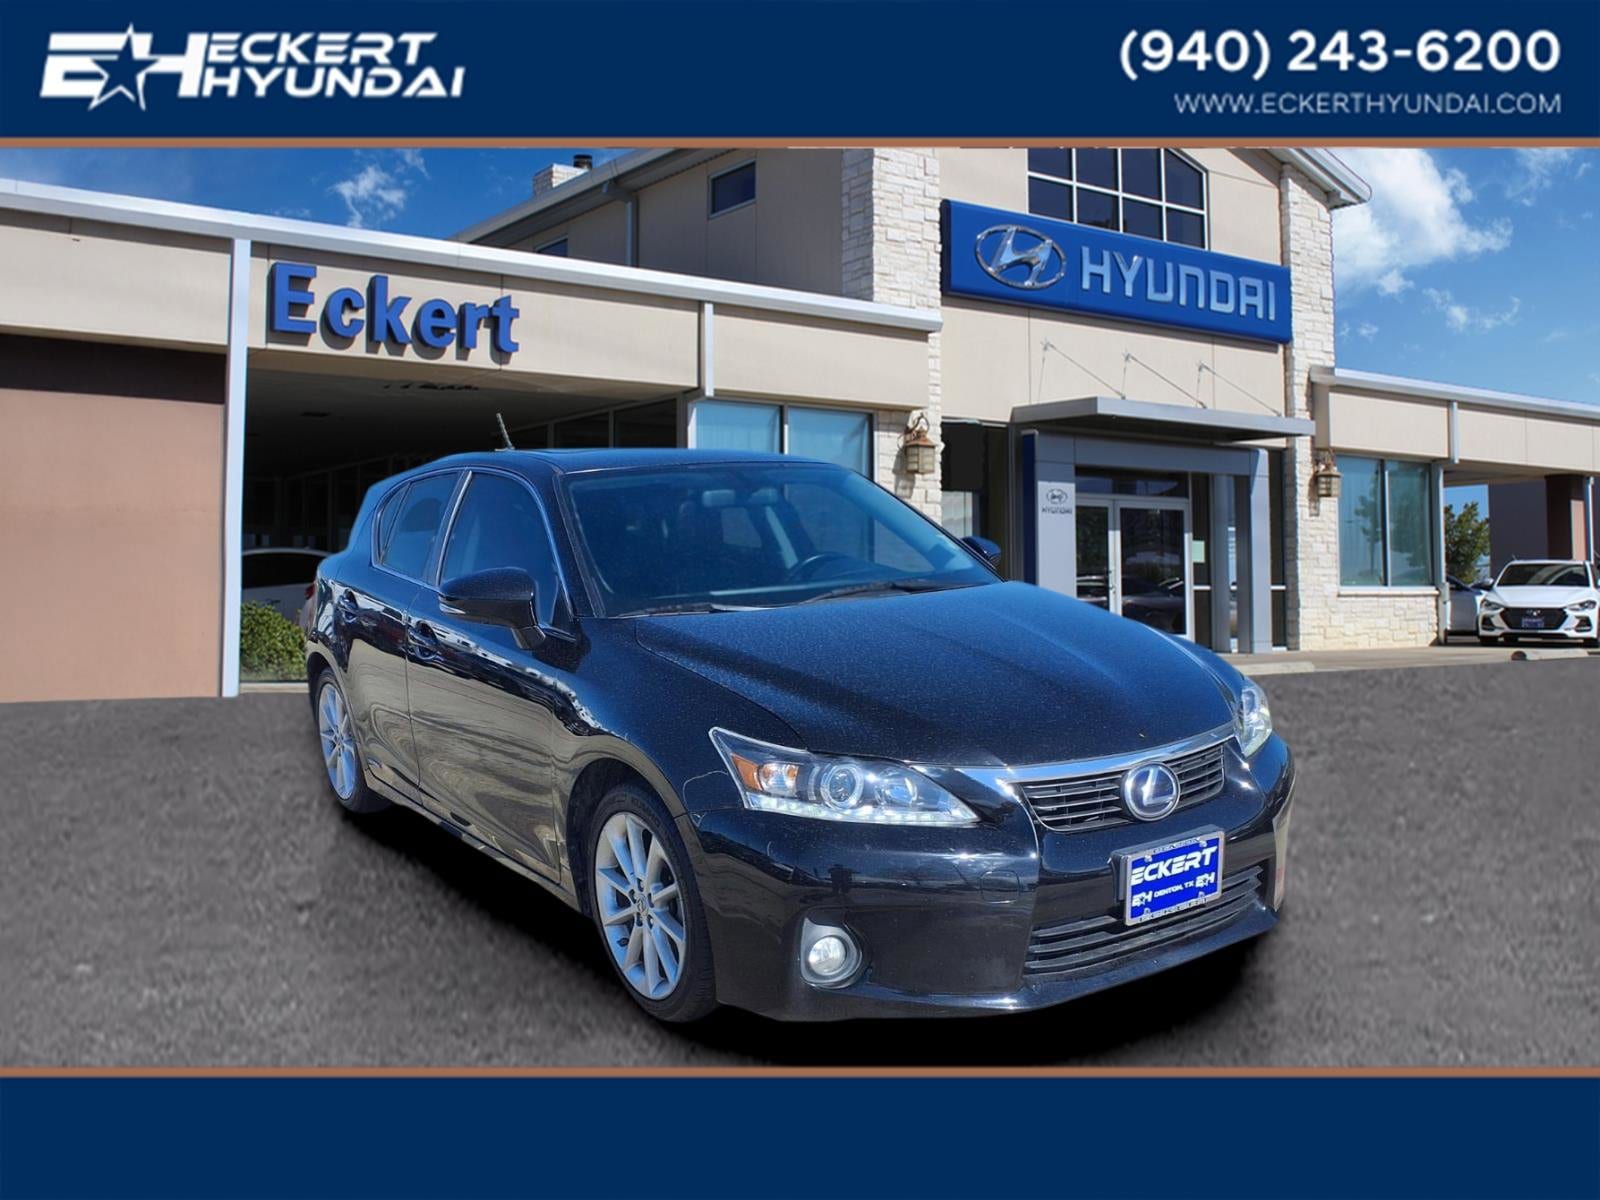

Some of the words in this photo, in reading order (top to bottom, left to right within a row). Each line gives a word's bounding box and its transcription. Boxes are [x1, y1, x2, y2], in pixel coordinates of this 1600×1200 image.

[270, 262, 519, 353] Eckert
[1081, 246, 1276, 321] HYUNDAI
[1131, 846, 1218, 886] ECKERT
[1184, 880, 1195, 890] TX
